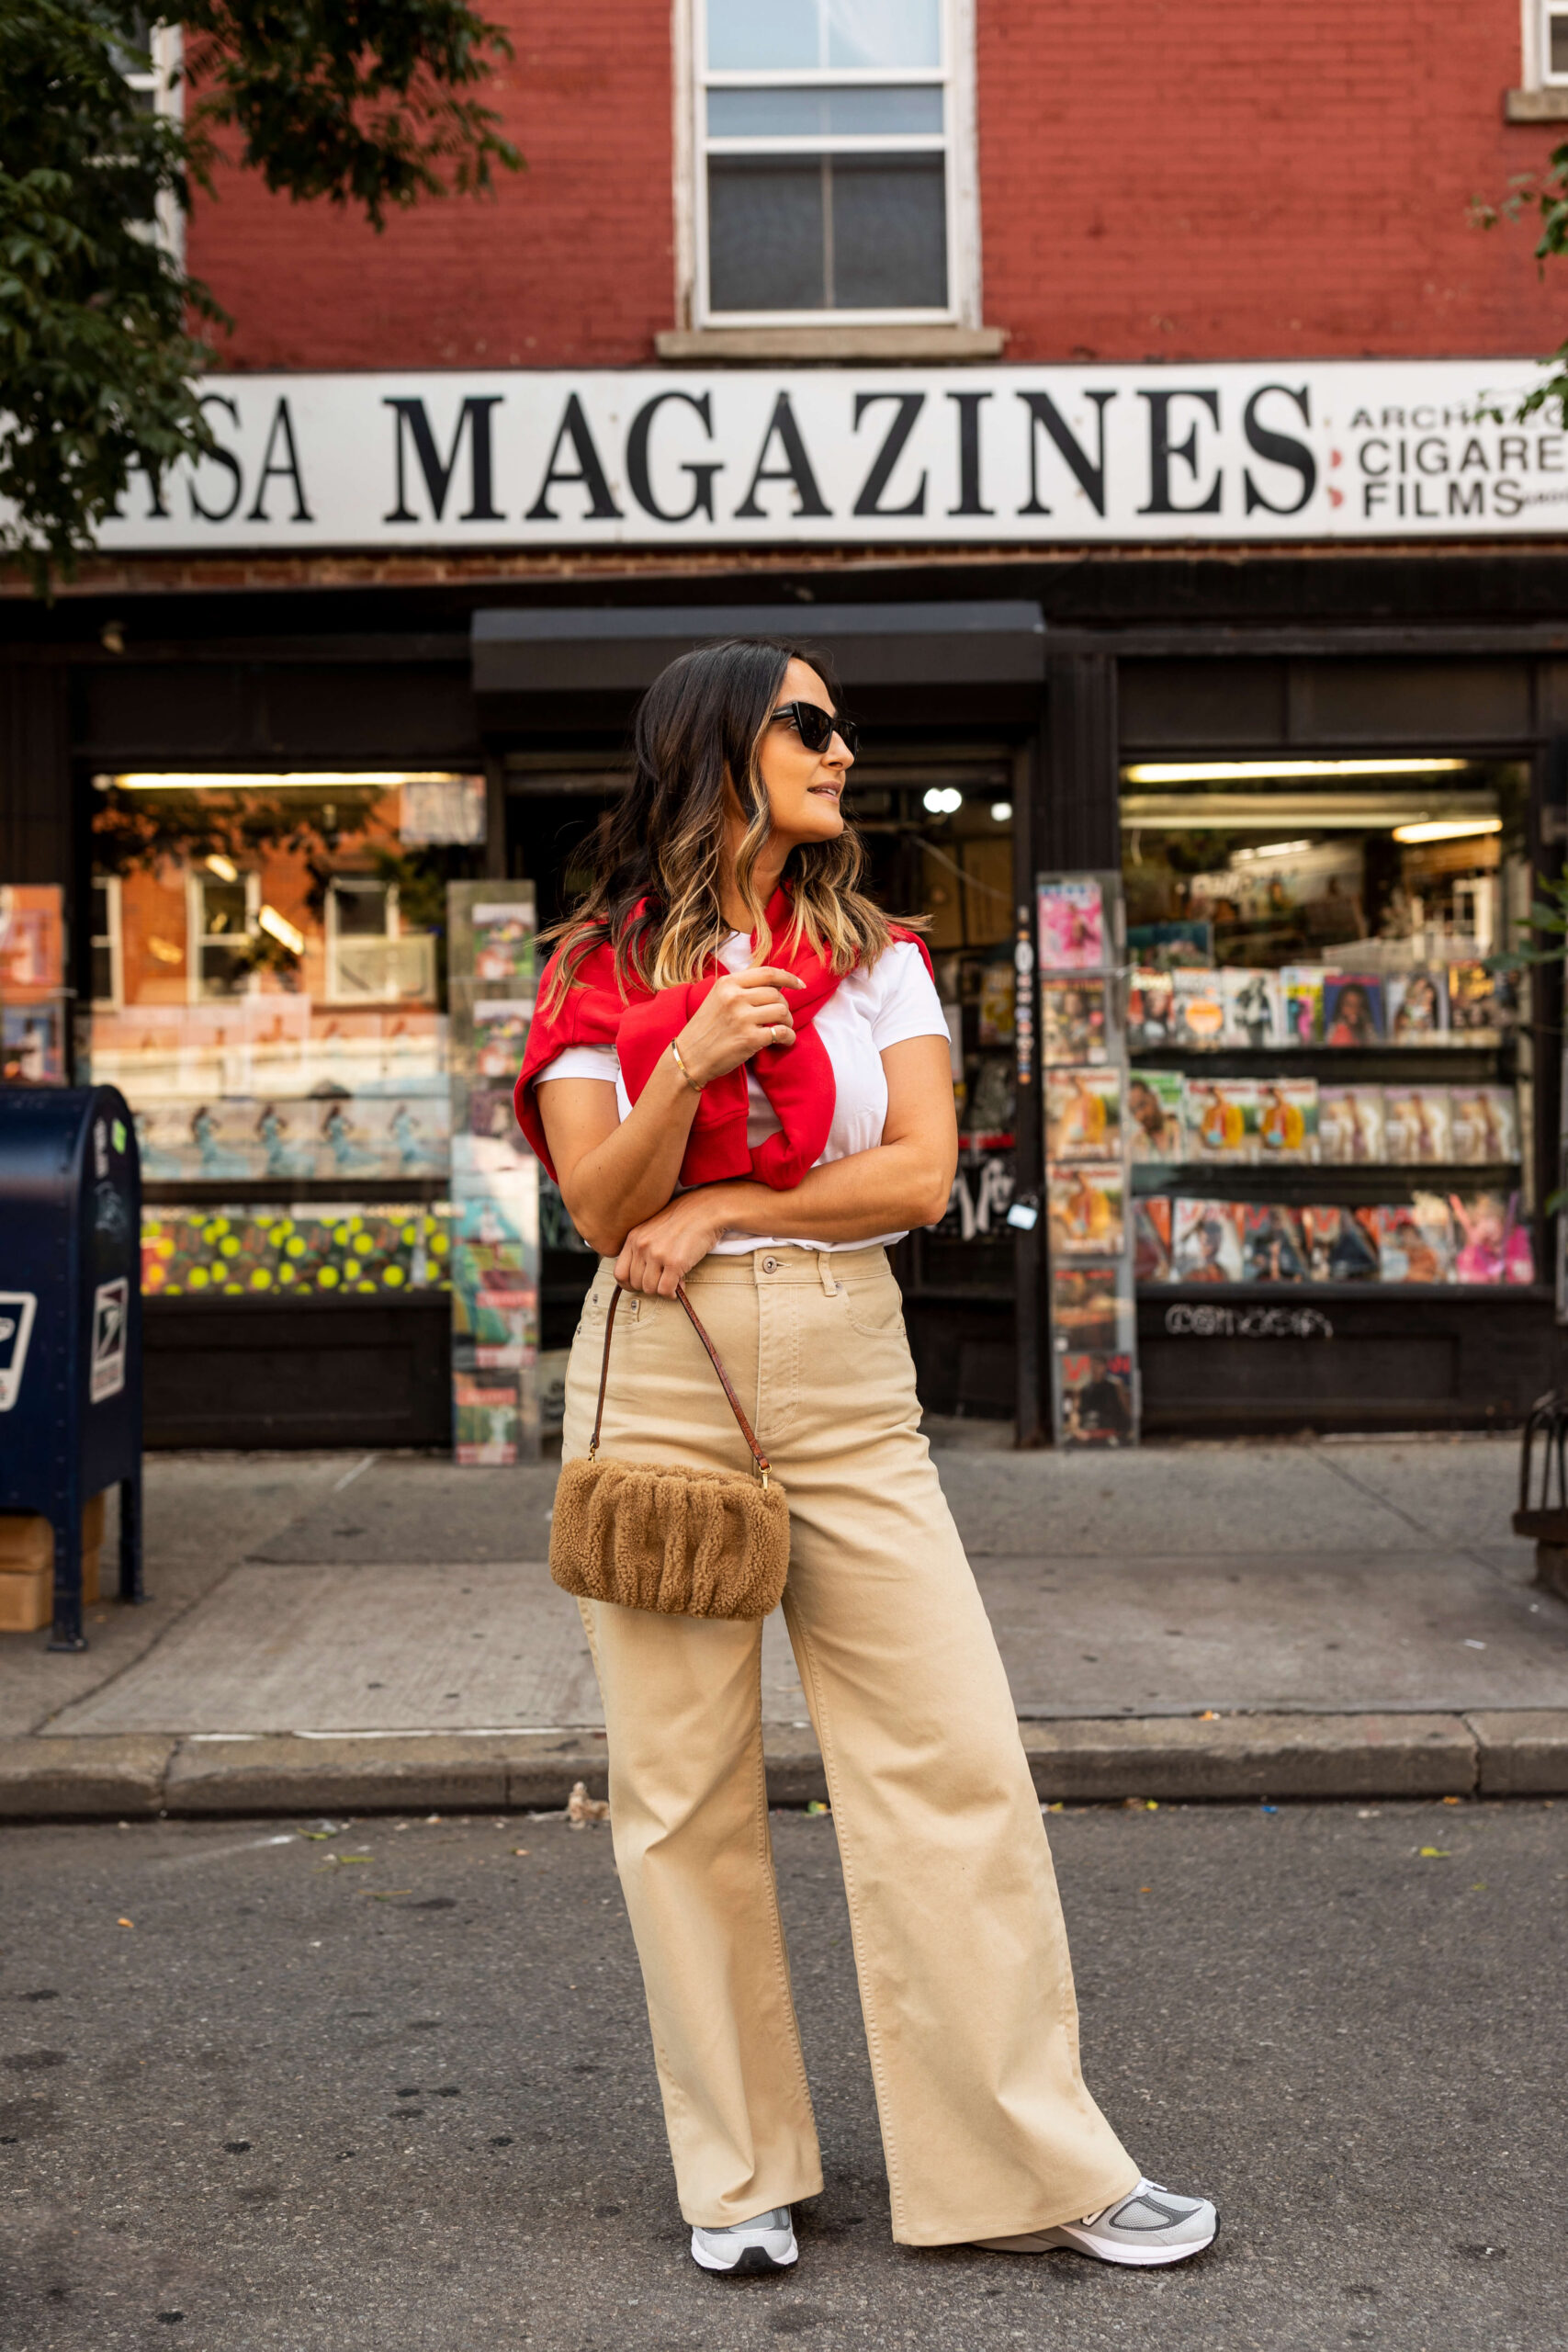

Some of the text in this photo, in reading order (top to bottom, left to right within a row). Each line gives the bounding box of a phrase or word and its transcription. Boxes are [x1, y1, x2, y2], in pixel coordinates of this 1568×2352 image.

[380, 383, 1318, 525] MAGAZINES
[1359, 435, 1565, 476] CIGARE
[1363, 480, 1522, 517] FILMS
